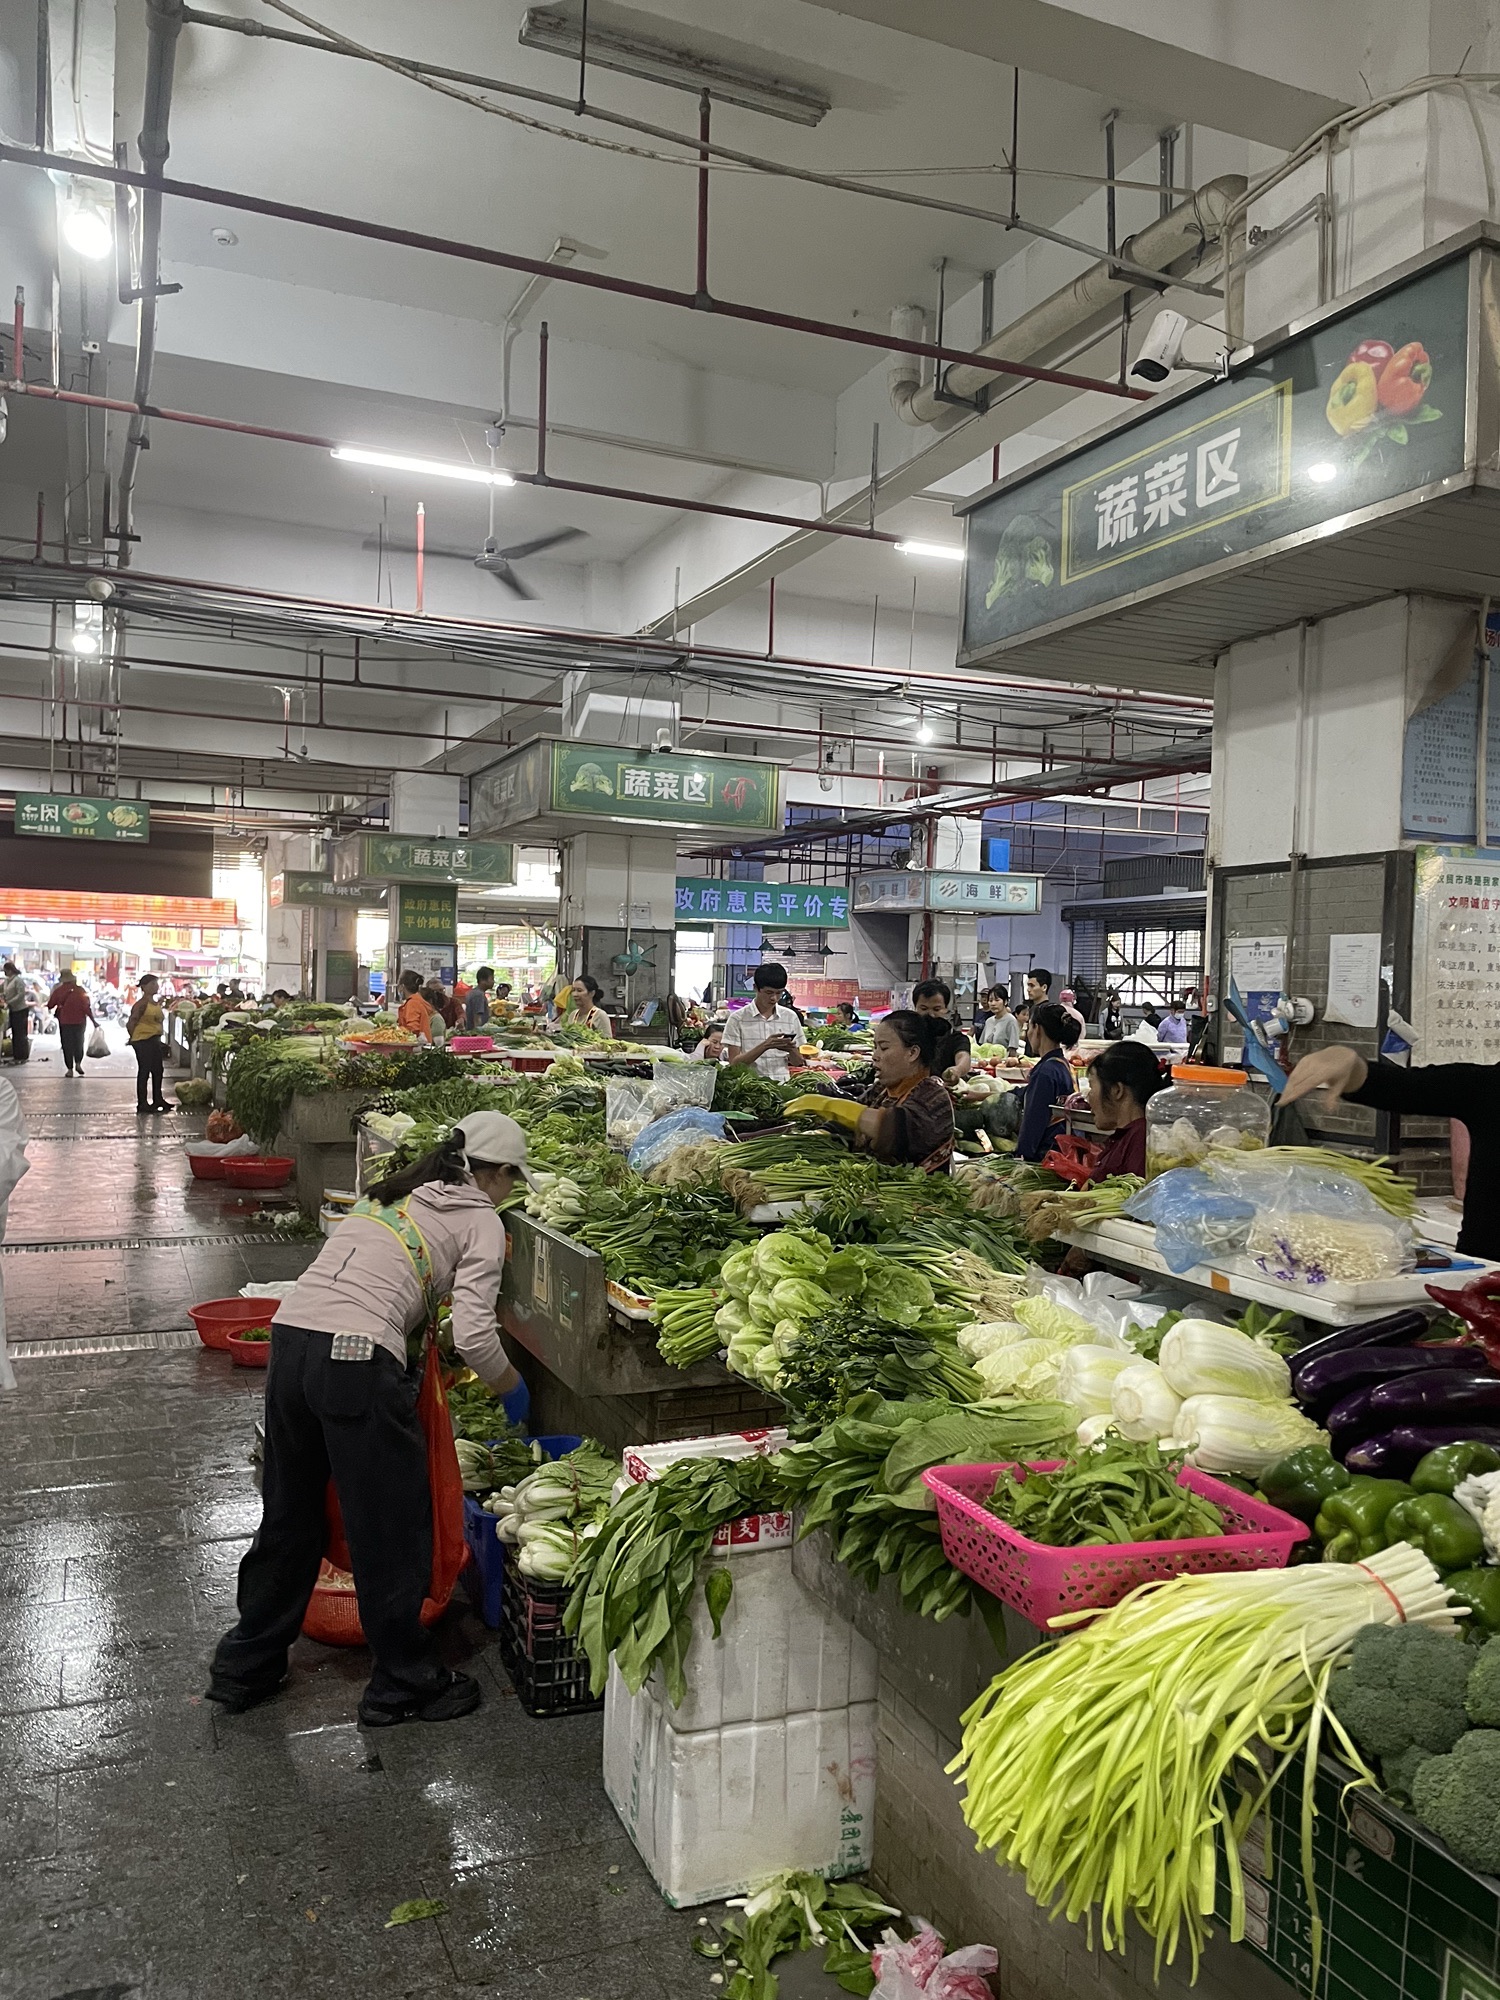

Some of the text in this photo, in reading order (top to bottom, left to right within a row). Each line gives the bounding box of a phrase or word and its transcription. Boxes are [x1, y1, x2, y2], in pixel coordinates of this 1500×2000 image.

[1094, 428, 1241, 550] 蔬菜区
[624, 768, 707, 802] 蔬菜区
[413, 848, 468, 868] 蔬菜区
[322, 882, 363, 896] 蔬菜区
[966, 883, 1002, 899] 海鲜
[404, 899, 452, 912] 政府惠民
[675, 887, 849, 919] 政府惠民平价专
[404, 916, 452, 929] 平价摊位
[1293, 1917, 1313, 1944] 13
[1290, 1952, 1311, 1978] 14
